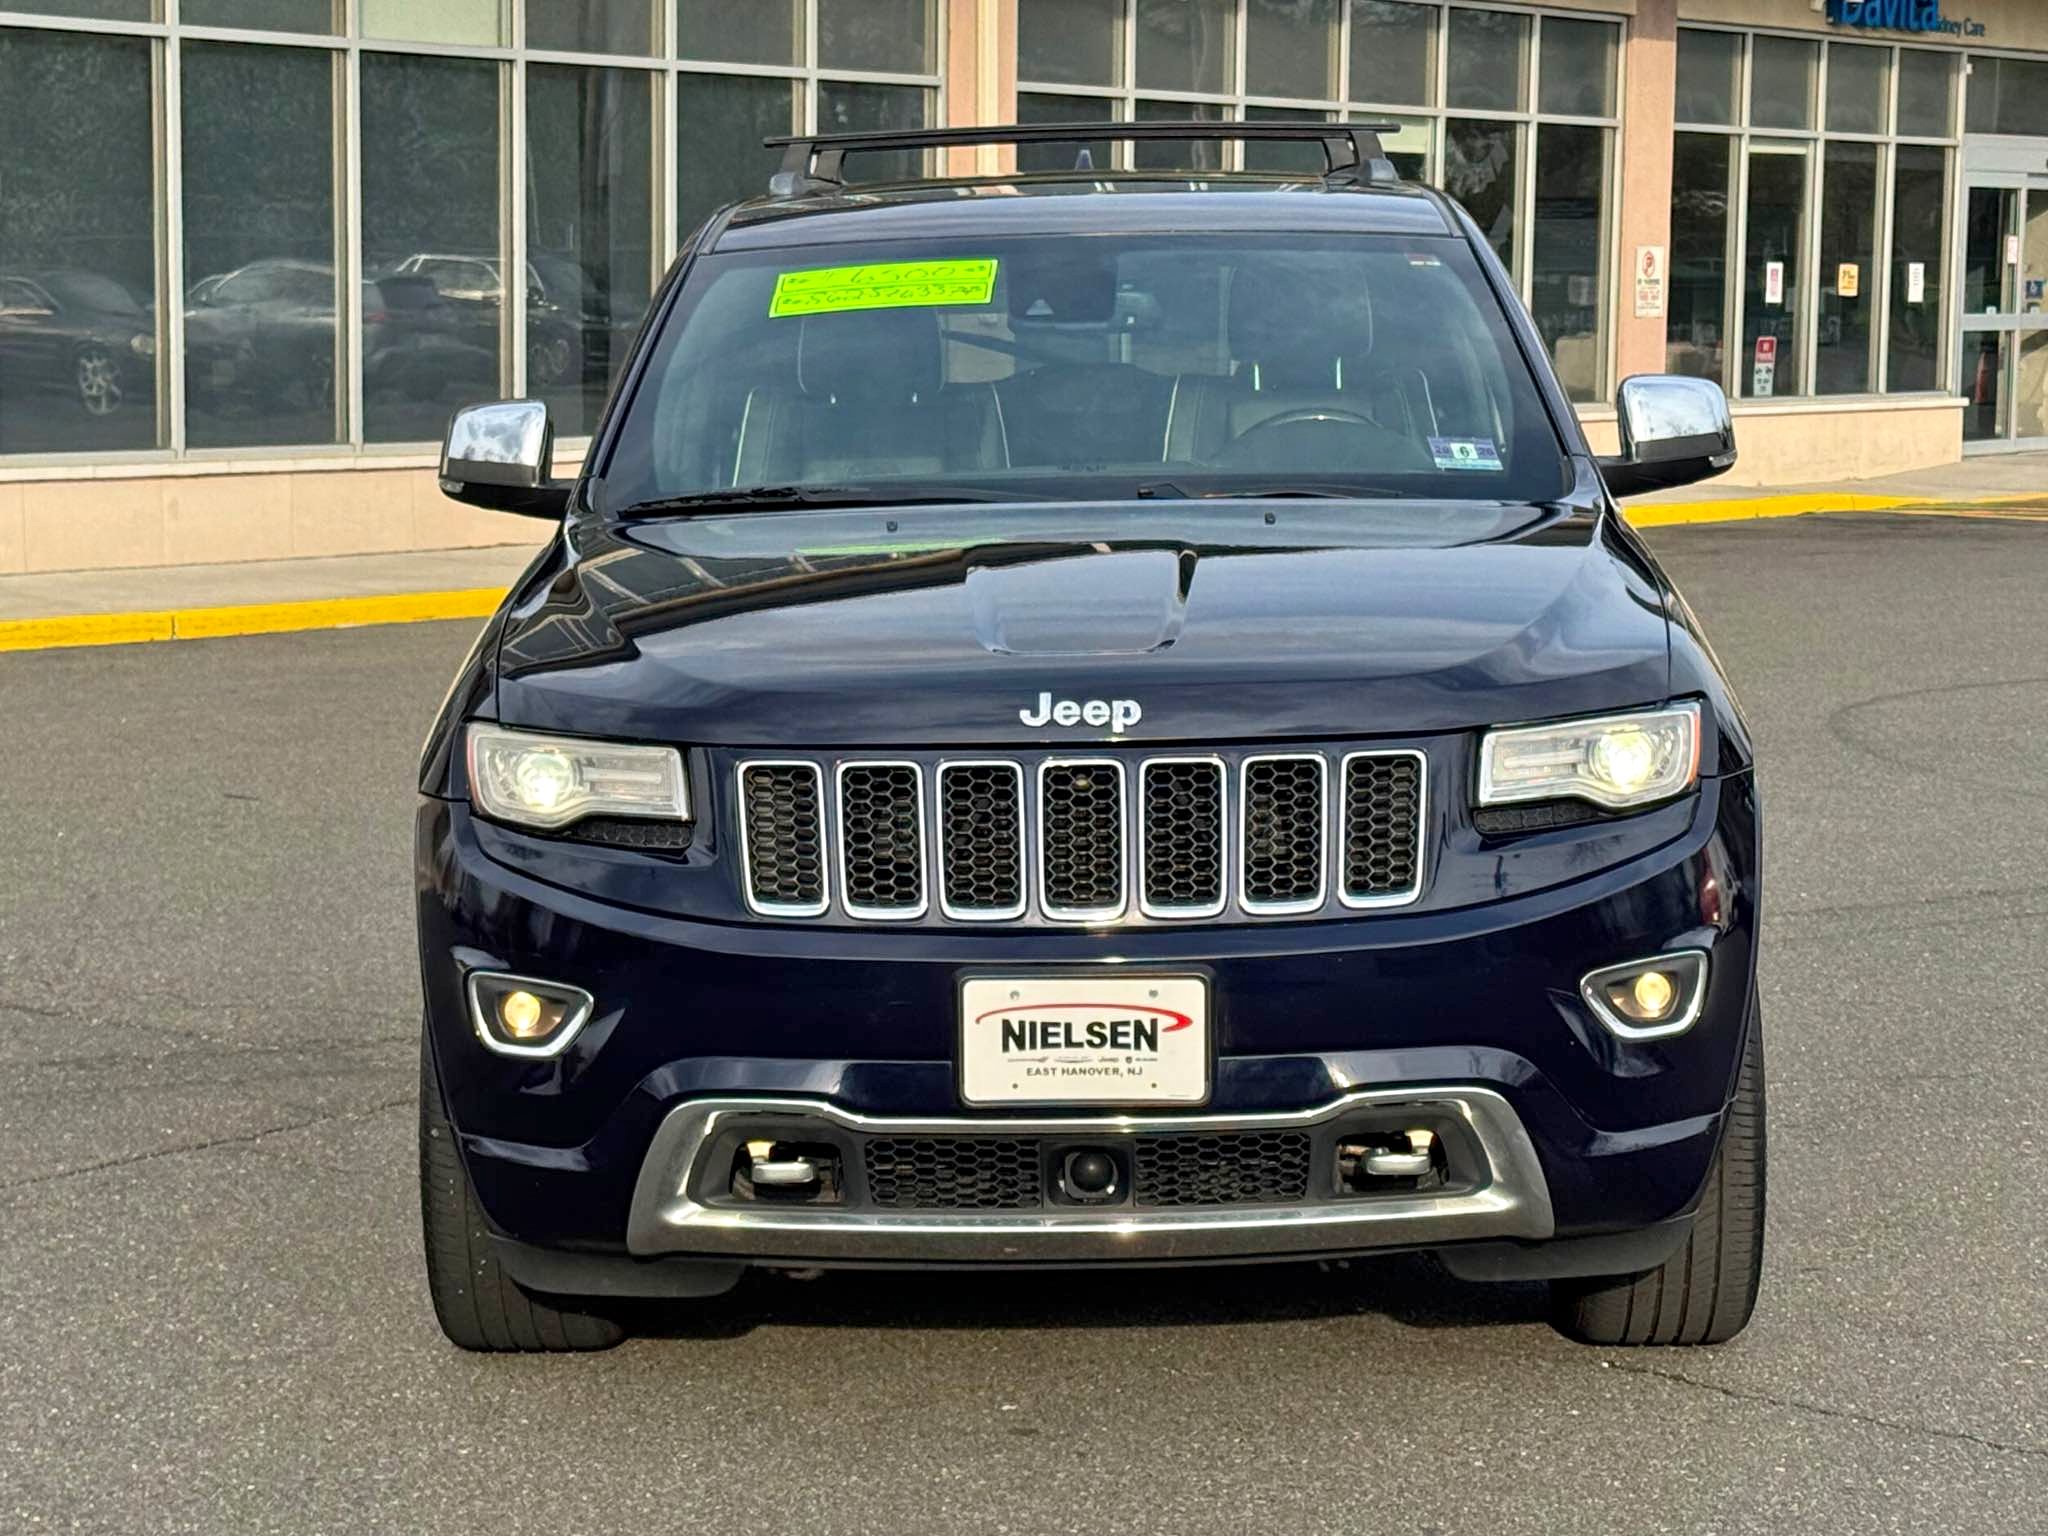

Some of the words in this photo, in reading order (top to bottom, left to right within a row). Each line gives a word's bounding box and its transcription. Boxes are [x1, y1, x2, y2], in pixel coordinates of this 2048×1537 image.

[1460, 446, 1470, 458] 6
[1019, 692, 1142, 733] Jeep
[1001, 1018, 1159, 1053] NIELSEN
[1026, 1067, 1058, 1077] EAST
[1061, 1066, 1124, 1078] HANOVER,
[1127, 1066, 1143, 1076] NJ
